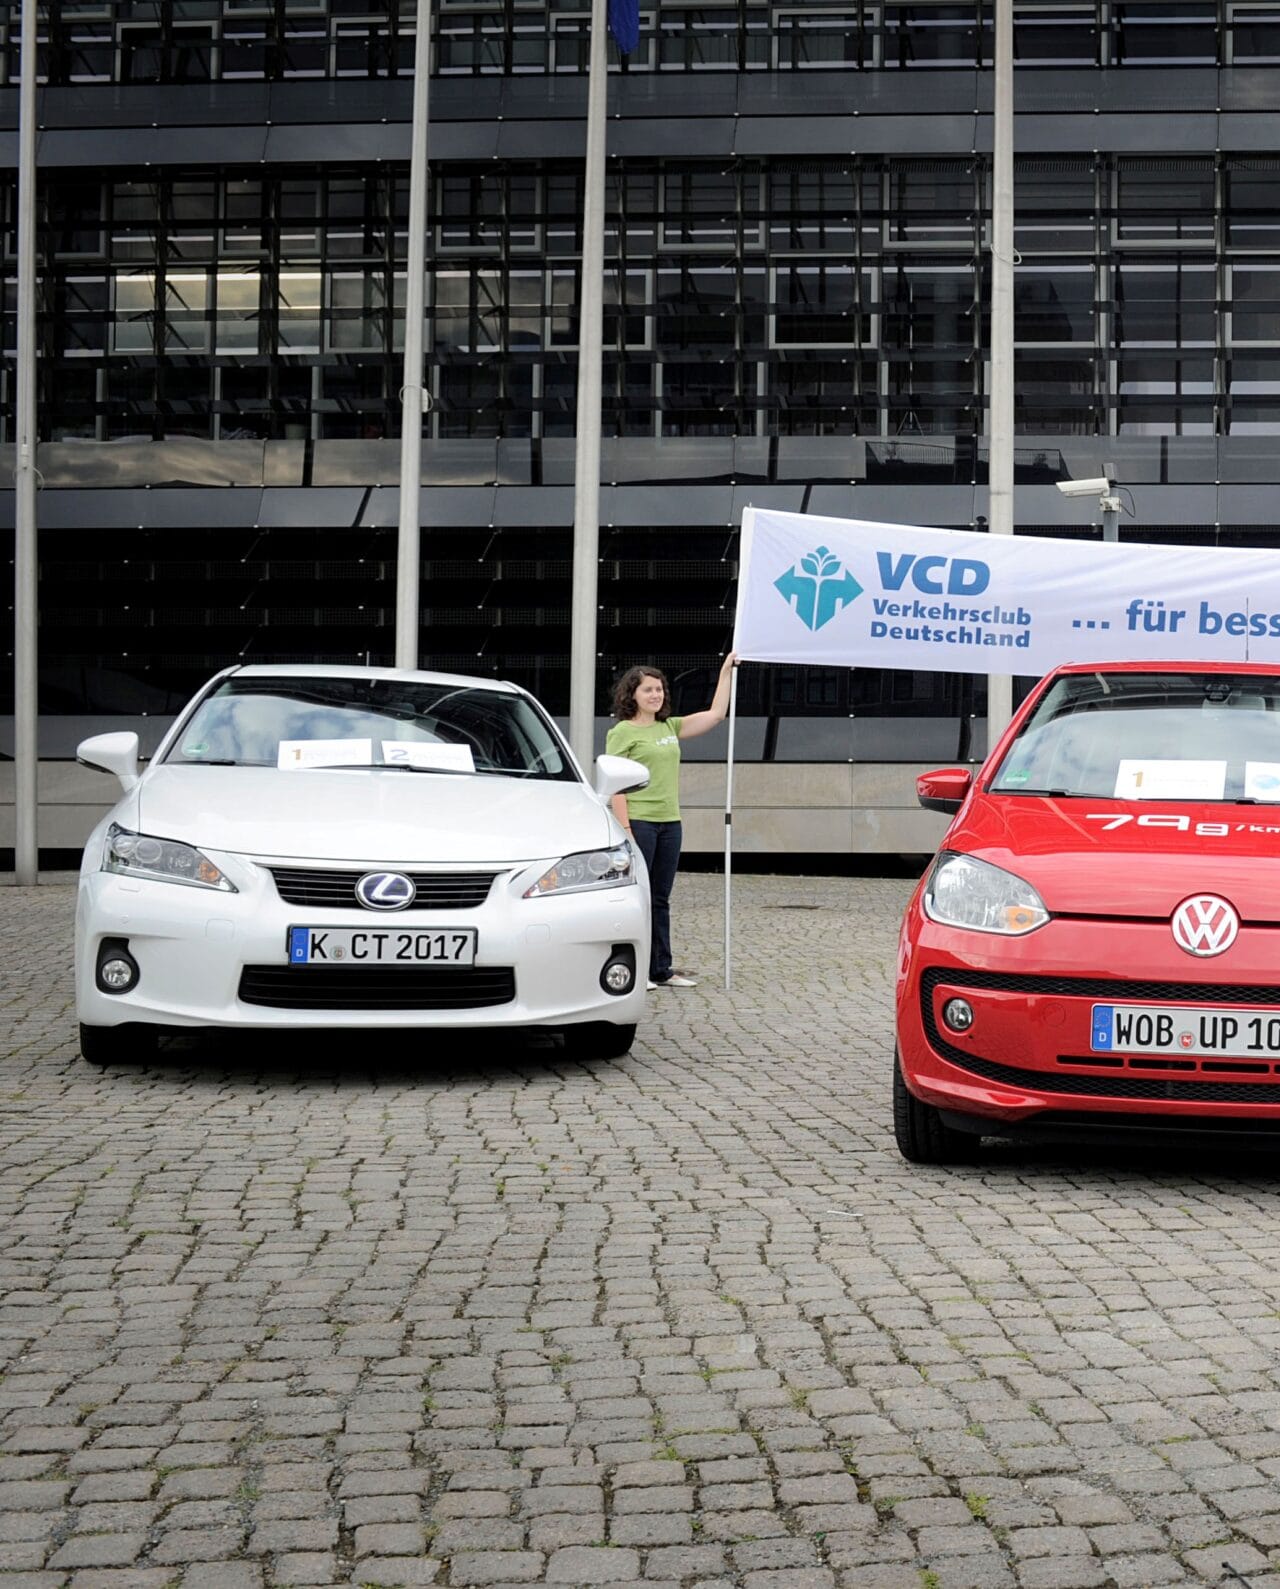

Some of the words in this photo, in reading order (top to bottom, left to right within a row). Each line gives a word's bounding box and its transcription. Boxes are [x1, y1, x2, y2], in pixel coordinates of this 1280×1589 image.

[876, 552, 991, 596] VCD
[872, 598, 1031, 626] Verkehrsclub
[1125, 599, 1186, 632] für
[871, 621, 1031, 648] Deutschland
[1132, 771, 1144, 787] 1
[310, 933, 329, 959] K
[351, 934, 389, 960] CT
[396, 934, 468, 960] 2017
[1099, 1032, 1107, 1042] D
[1116, 1013, 1174, 1047] WOB
[1199, 1016, 1238, 1049] UP
